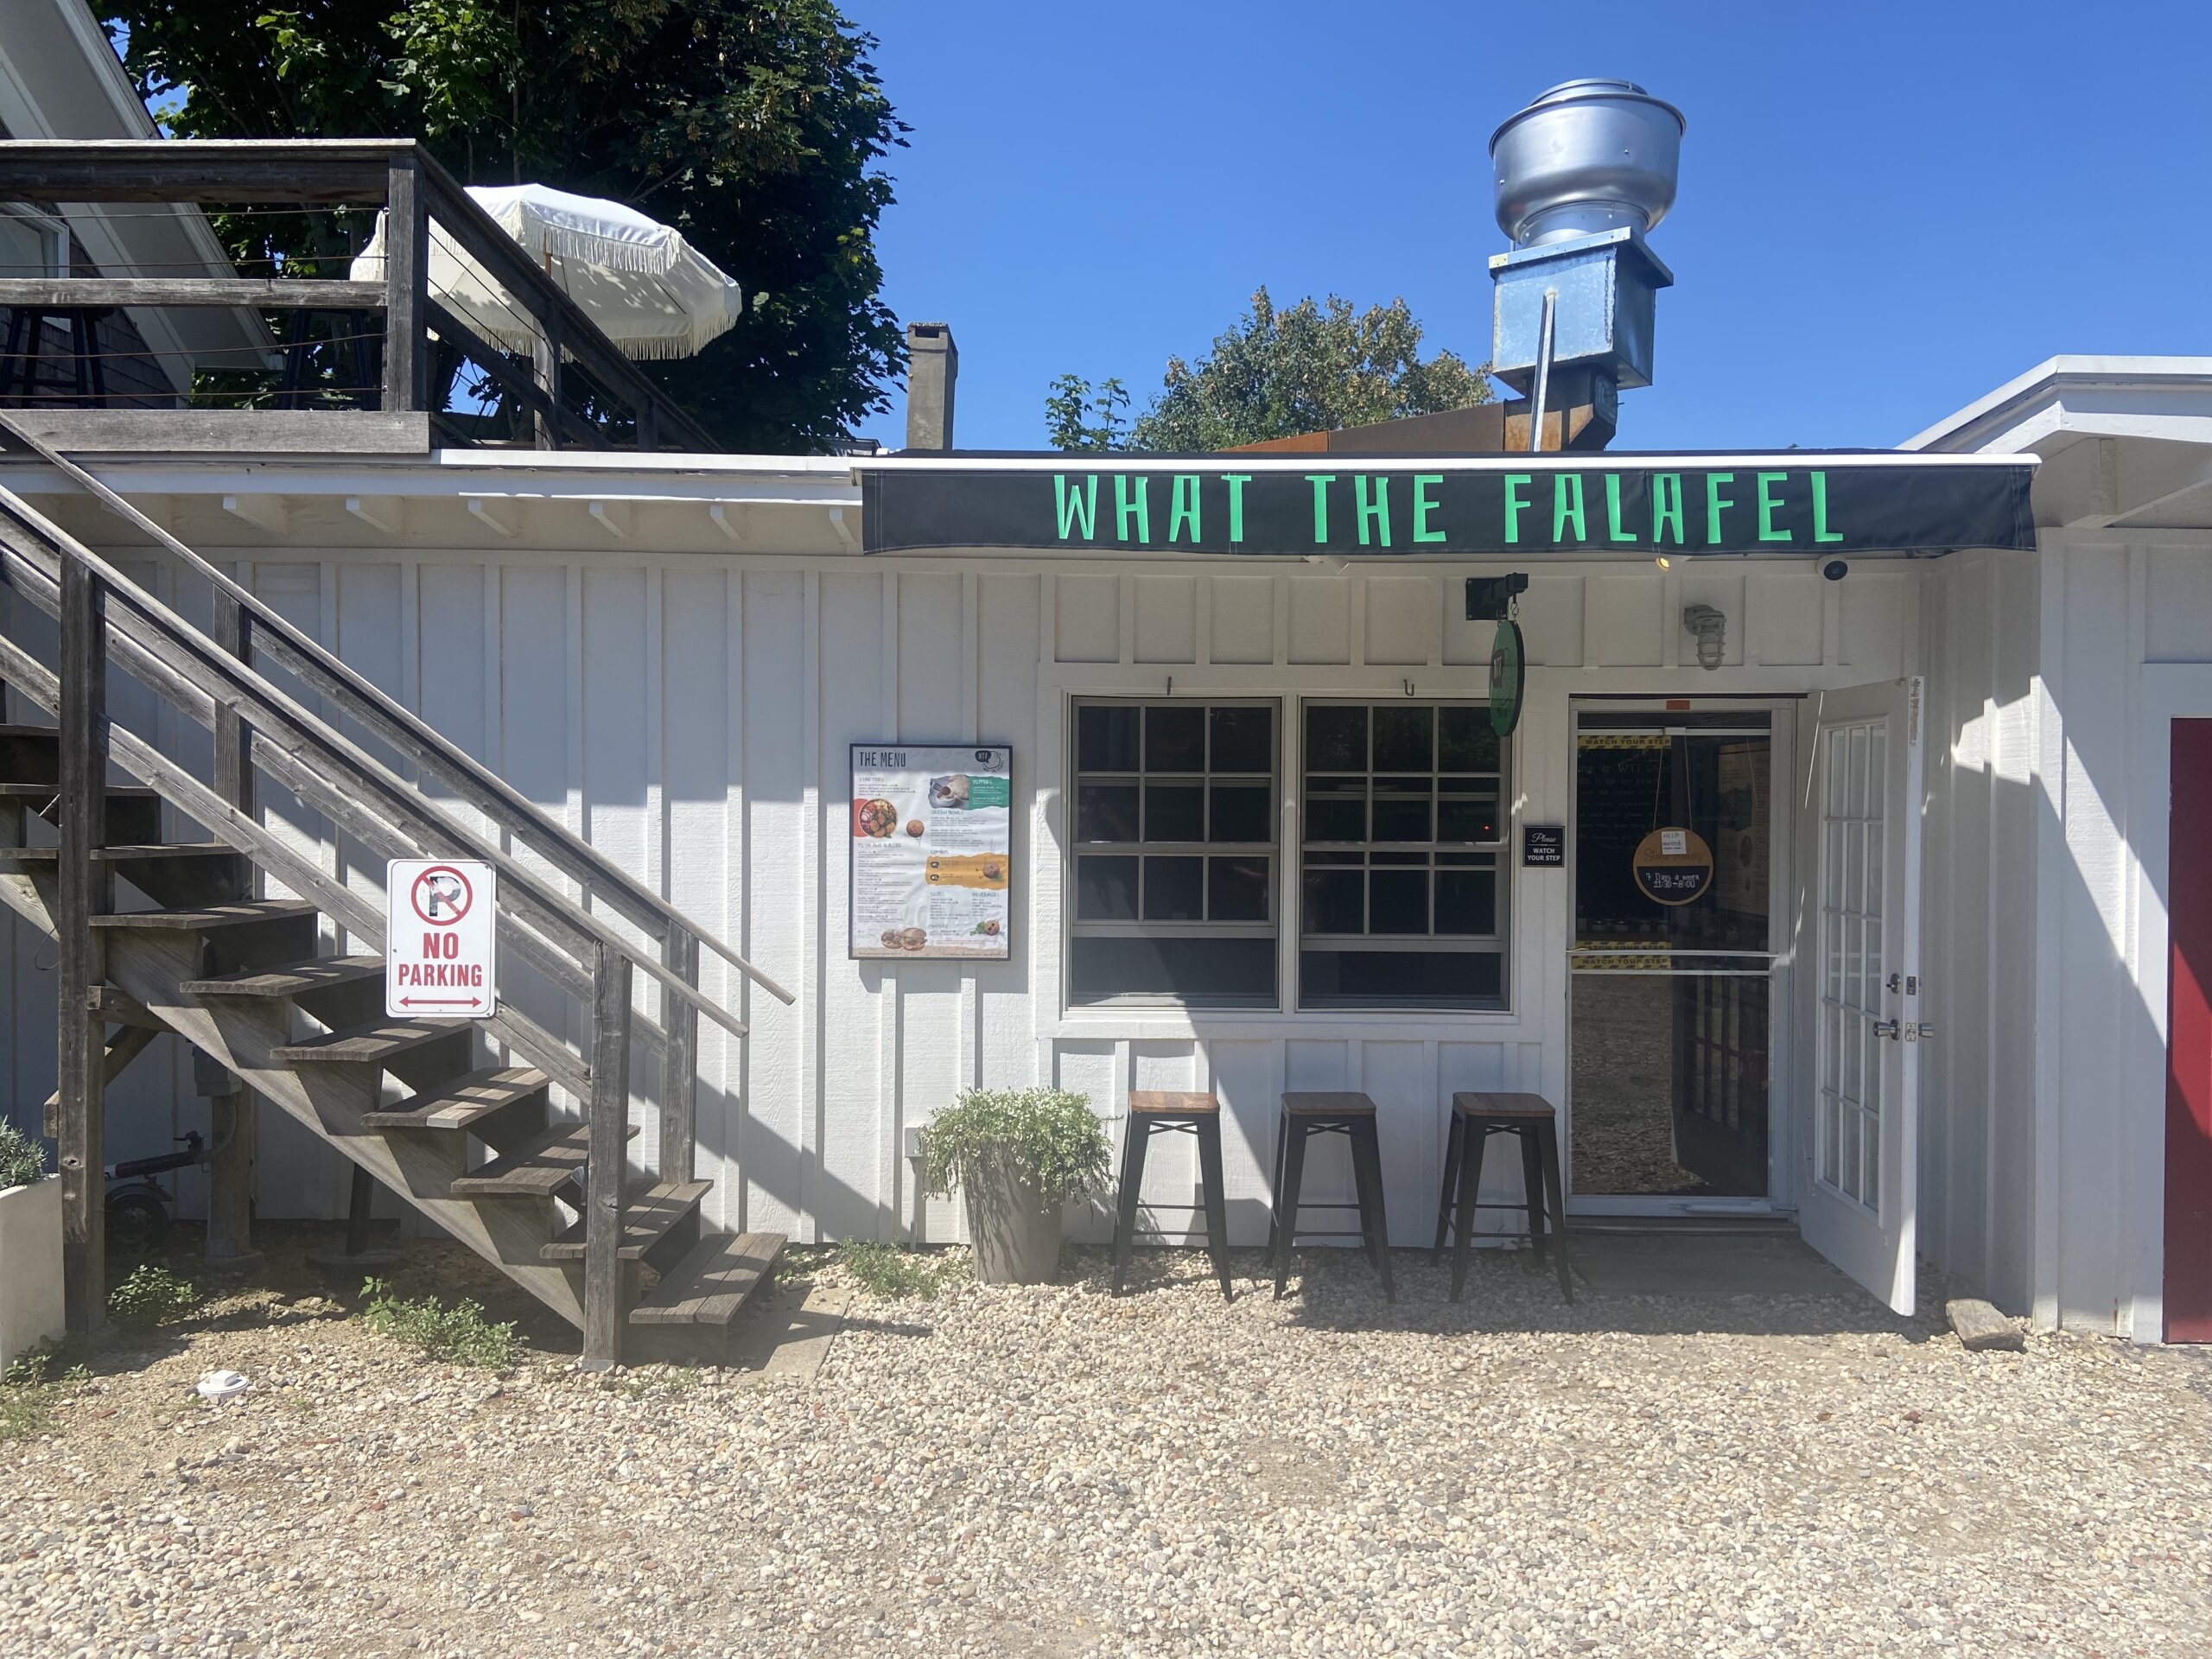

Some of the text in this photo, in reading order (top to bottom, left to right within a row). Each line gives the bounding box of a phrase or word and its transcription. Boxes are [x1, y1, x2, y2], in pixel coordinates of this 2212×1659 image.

[1053, 471, 1845, 547] WHAT THE FALAFEL
[859, 752, 906, 767] THE MENU
[1531, 832, 1556, 842] Please
[423, 932, 459, 960] NO
[398, 963, 482, 988] PARKING
